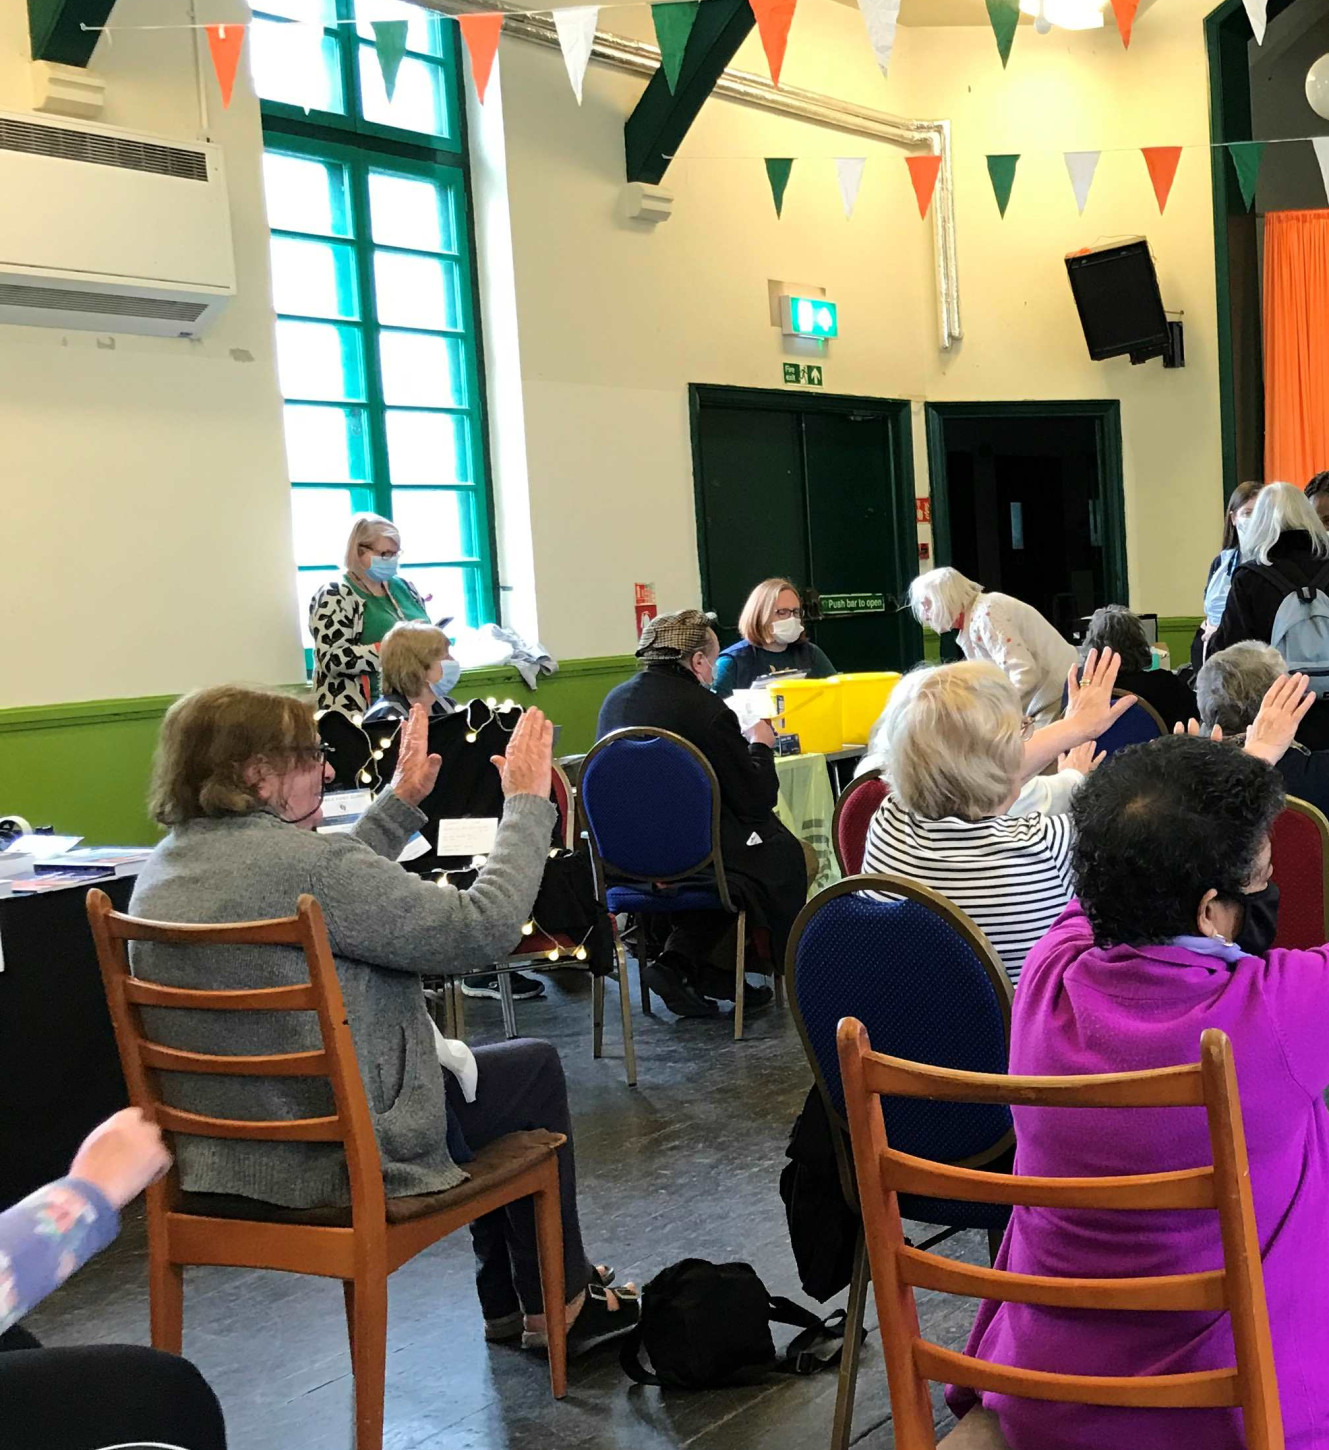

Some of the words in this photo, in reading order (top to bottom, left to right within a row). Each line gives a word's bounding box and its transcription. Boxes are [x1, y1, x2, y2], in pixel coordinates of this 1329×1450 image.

[828, 599, 846, 609] Push
[846, 598, 858, 608] bar
[858, 599, 866, 608] to
[866, 599, 882, 609] open
